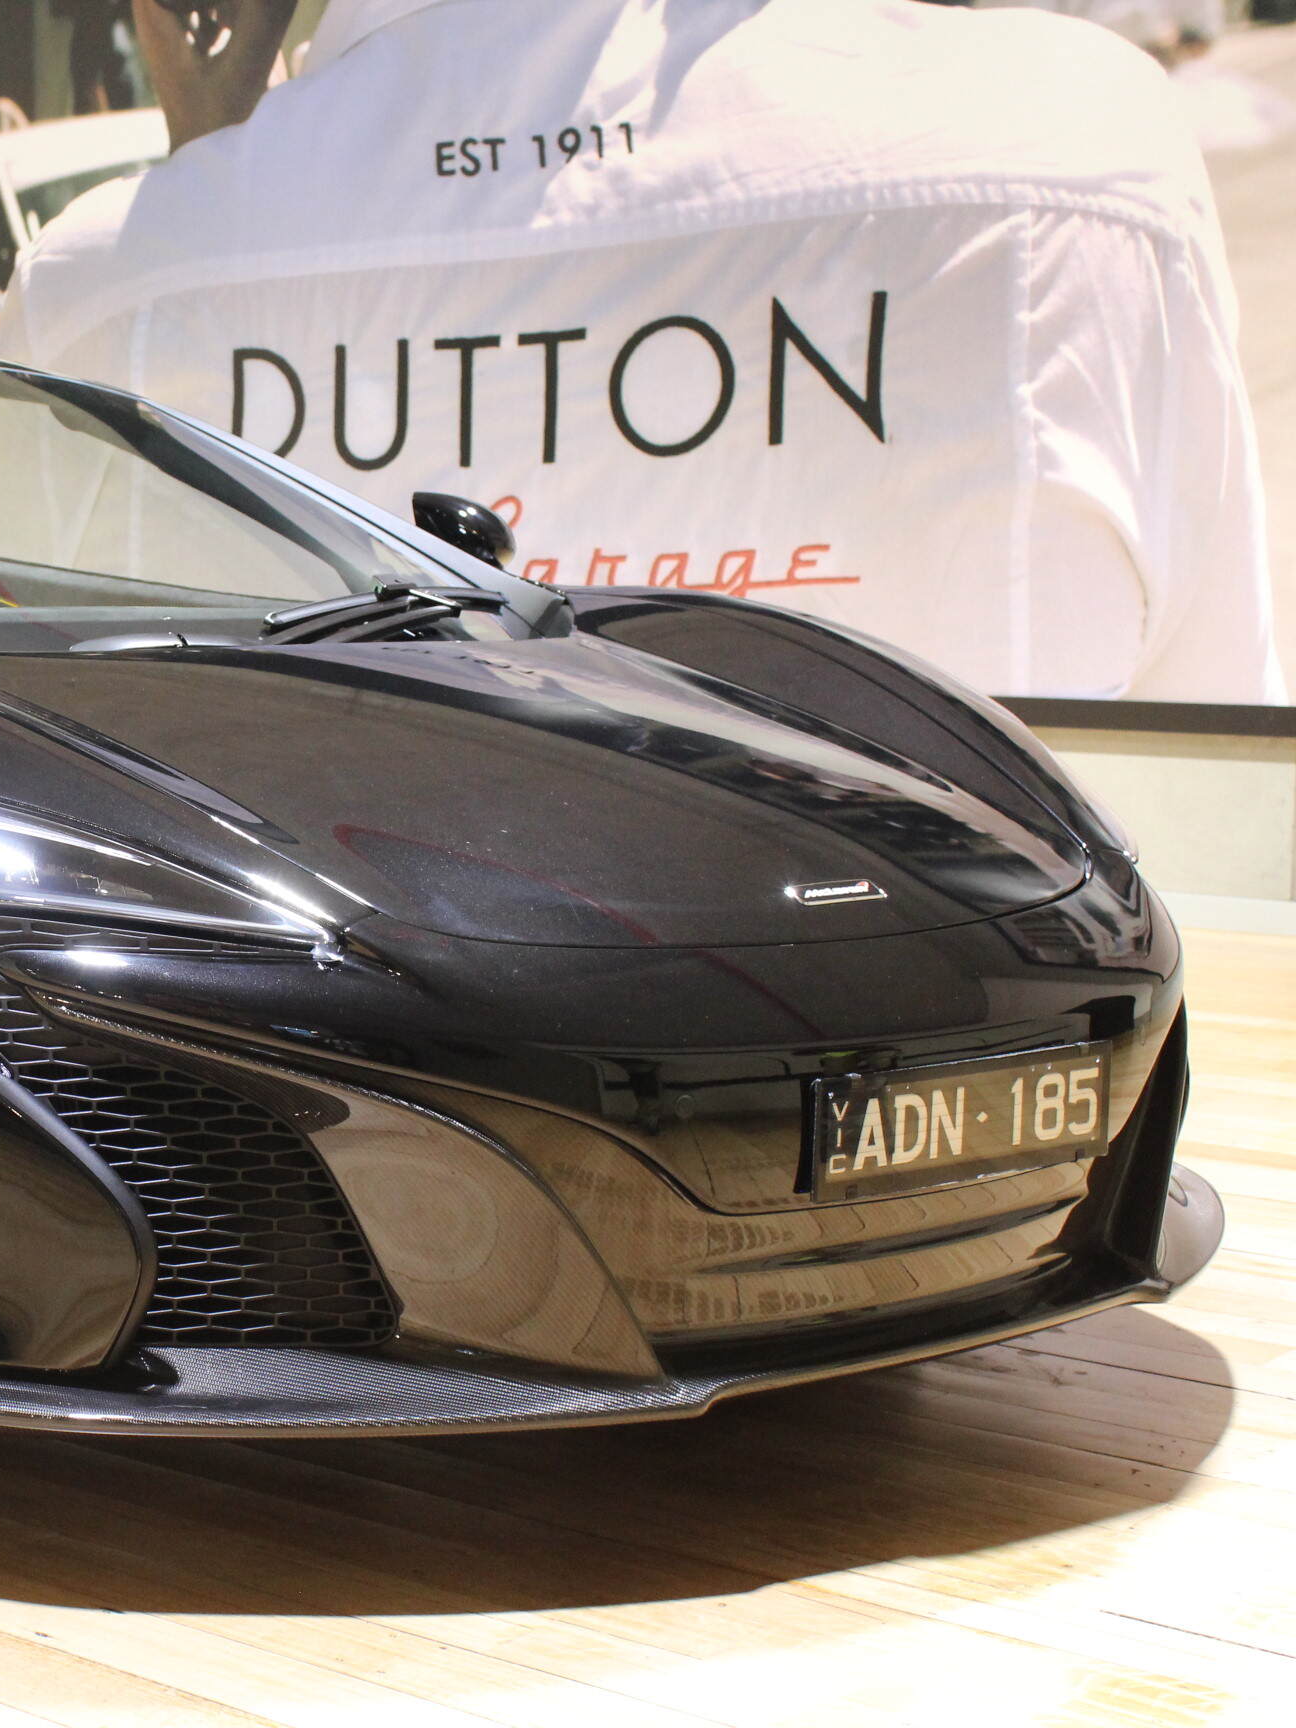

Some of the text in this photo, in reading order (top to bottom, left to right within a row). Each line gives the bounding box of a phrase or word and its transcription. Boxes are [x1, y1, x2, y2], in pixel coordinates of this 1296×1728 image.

[435, 122, 634, 177] EST 1911
[232, 290, 888, 471] DUTTON
[829, 1101, 849, 1175] VIC
[853, 1067, 1099, 1171] ADN 185
